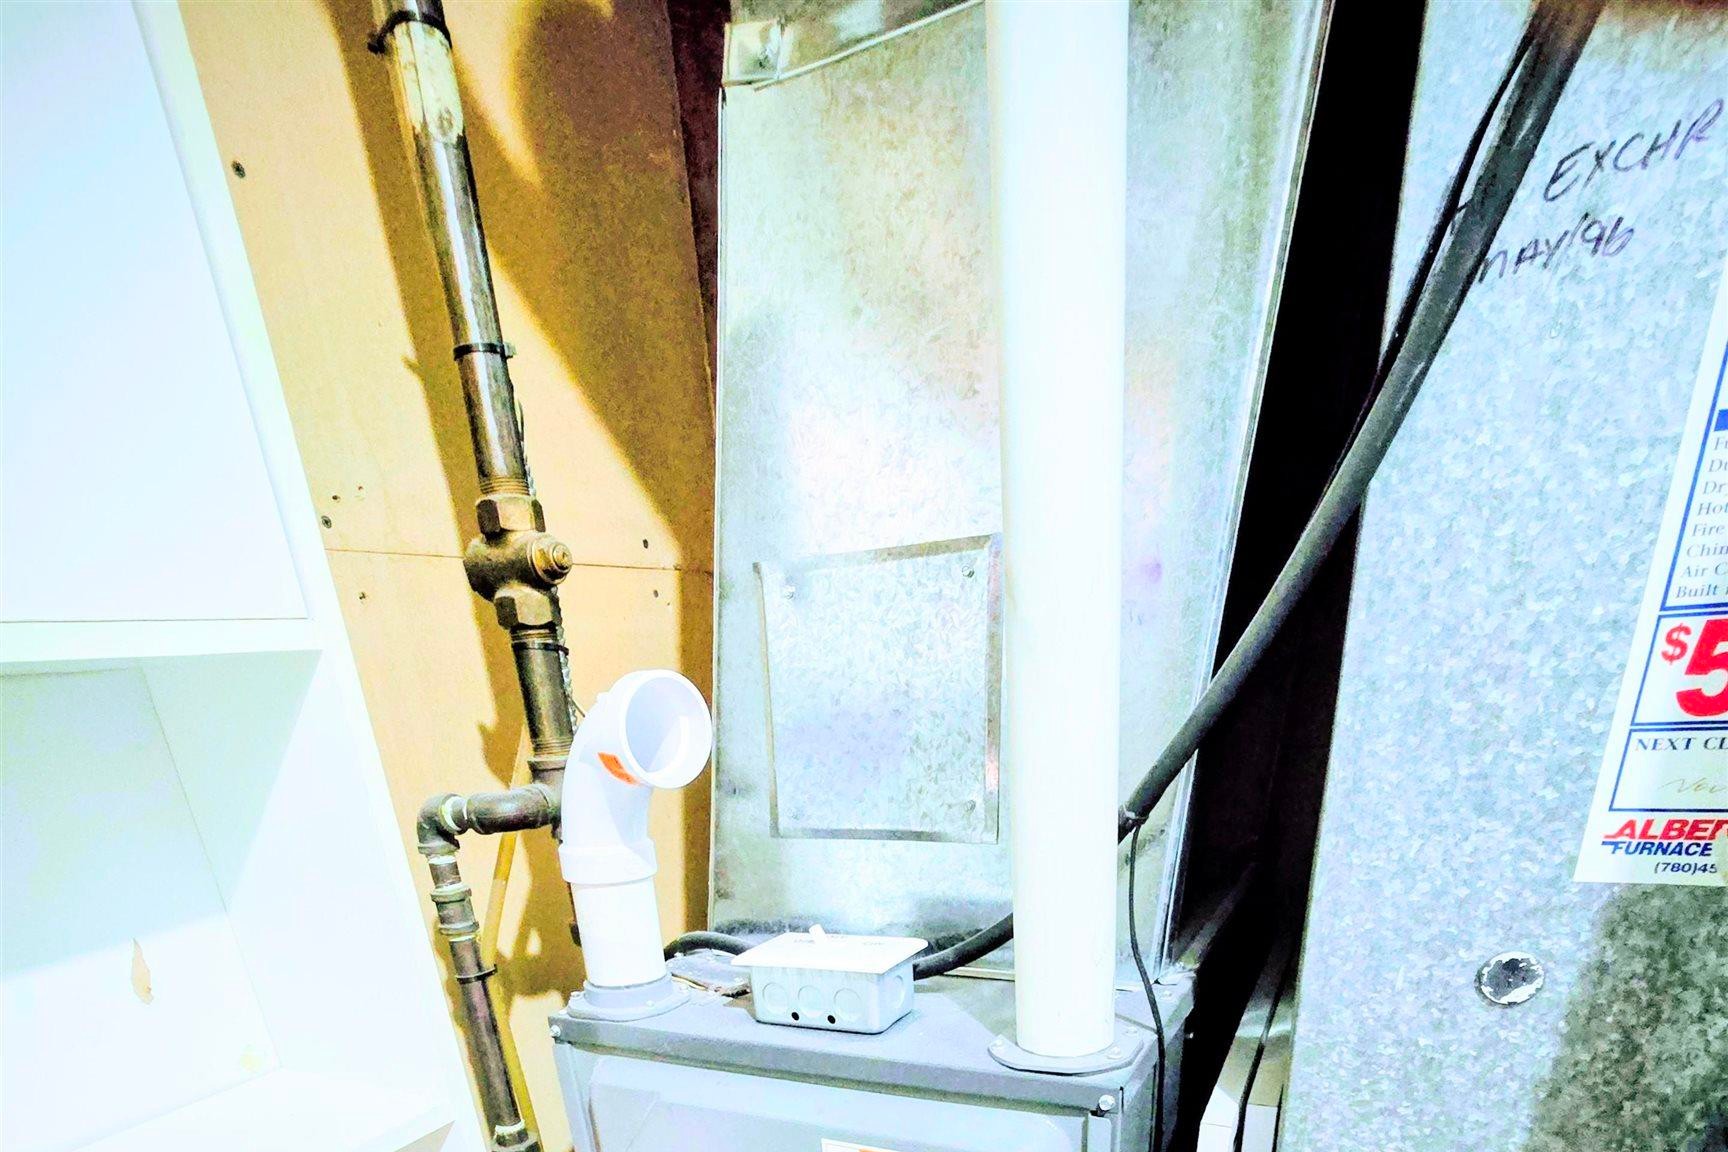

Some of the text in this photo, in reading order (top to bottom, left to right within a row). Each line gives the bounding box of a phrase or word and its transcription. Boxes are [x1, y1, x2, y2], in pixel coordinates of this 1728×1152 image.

[1692, 523, 1725, 536] Fire
[1681, 565, 1709, 578] Air
[1675, 583, 1718, 598] Built
[1634, 737, 1697, 751] NEXT
[1601, 841, 1713, 856] FURNACE
